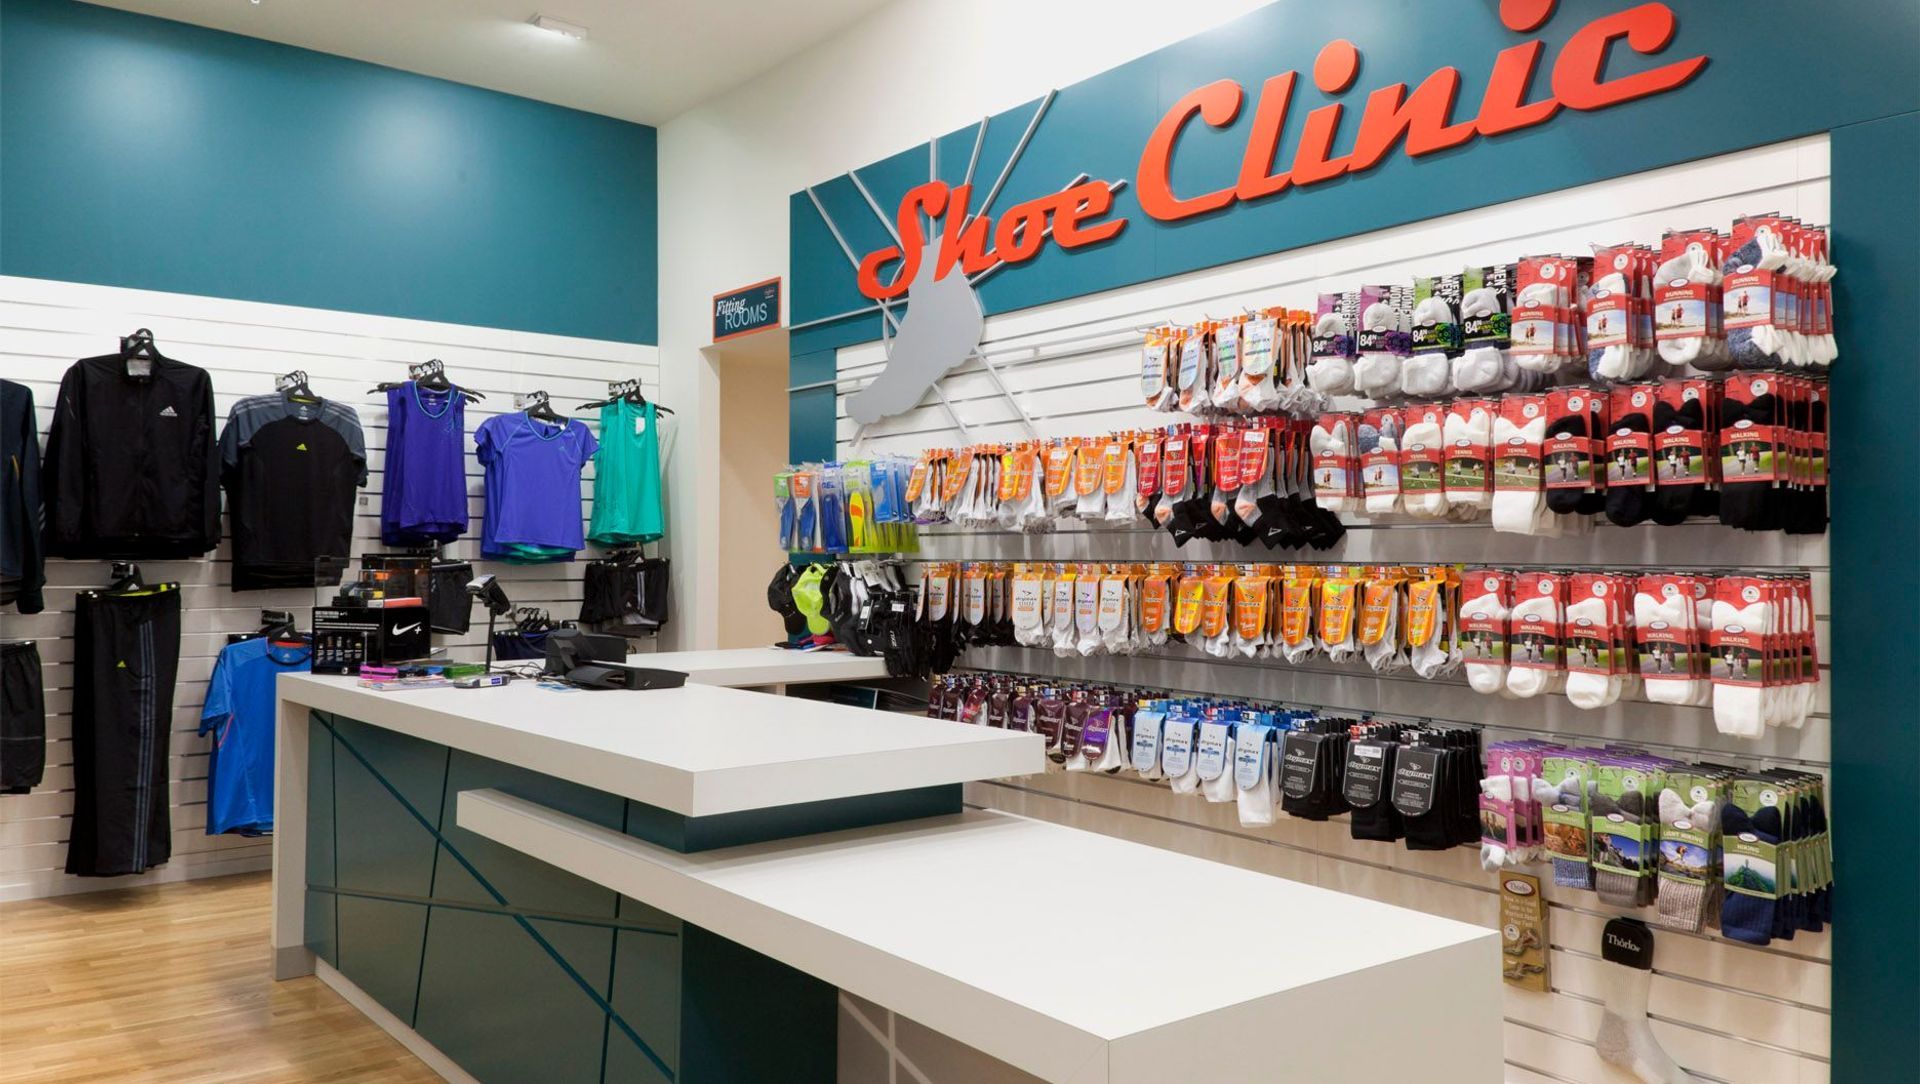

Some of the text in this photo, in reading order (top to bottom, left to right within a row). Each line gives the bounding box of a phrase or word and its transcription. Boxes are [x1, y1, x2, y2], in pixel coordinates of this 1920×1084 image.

[857, 0, 1709, 300] Shoe Clinic
[716, 298, 746, 317] Fitting
[725, 303, 767, 330] ROOMS
